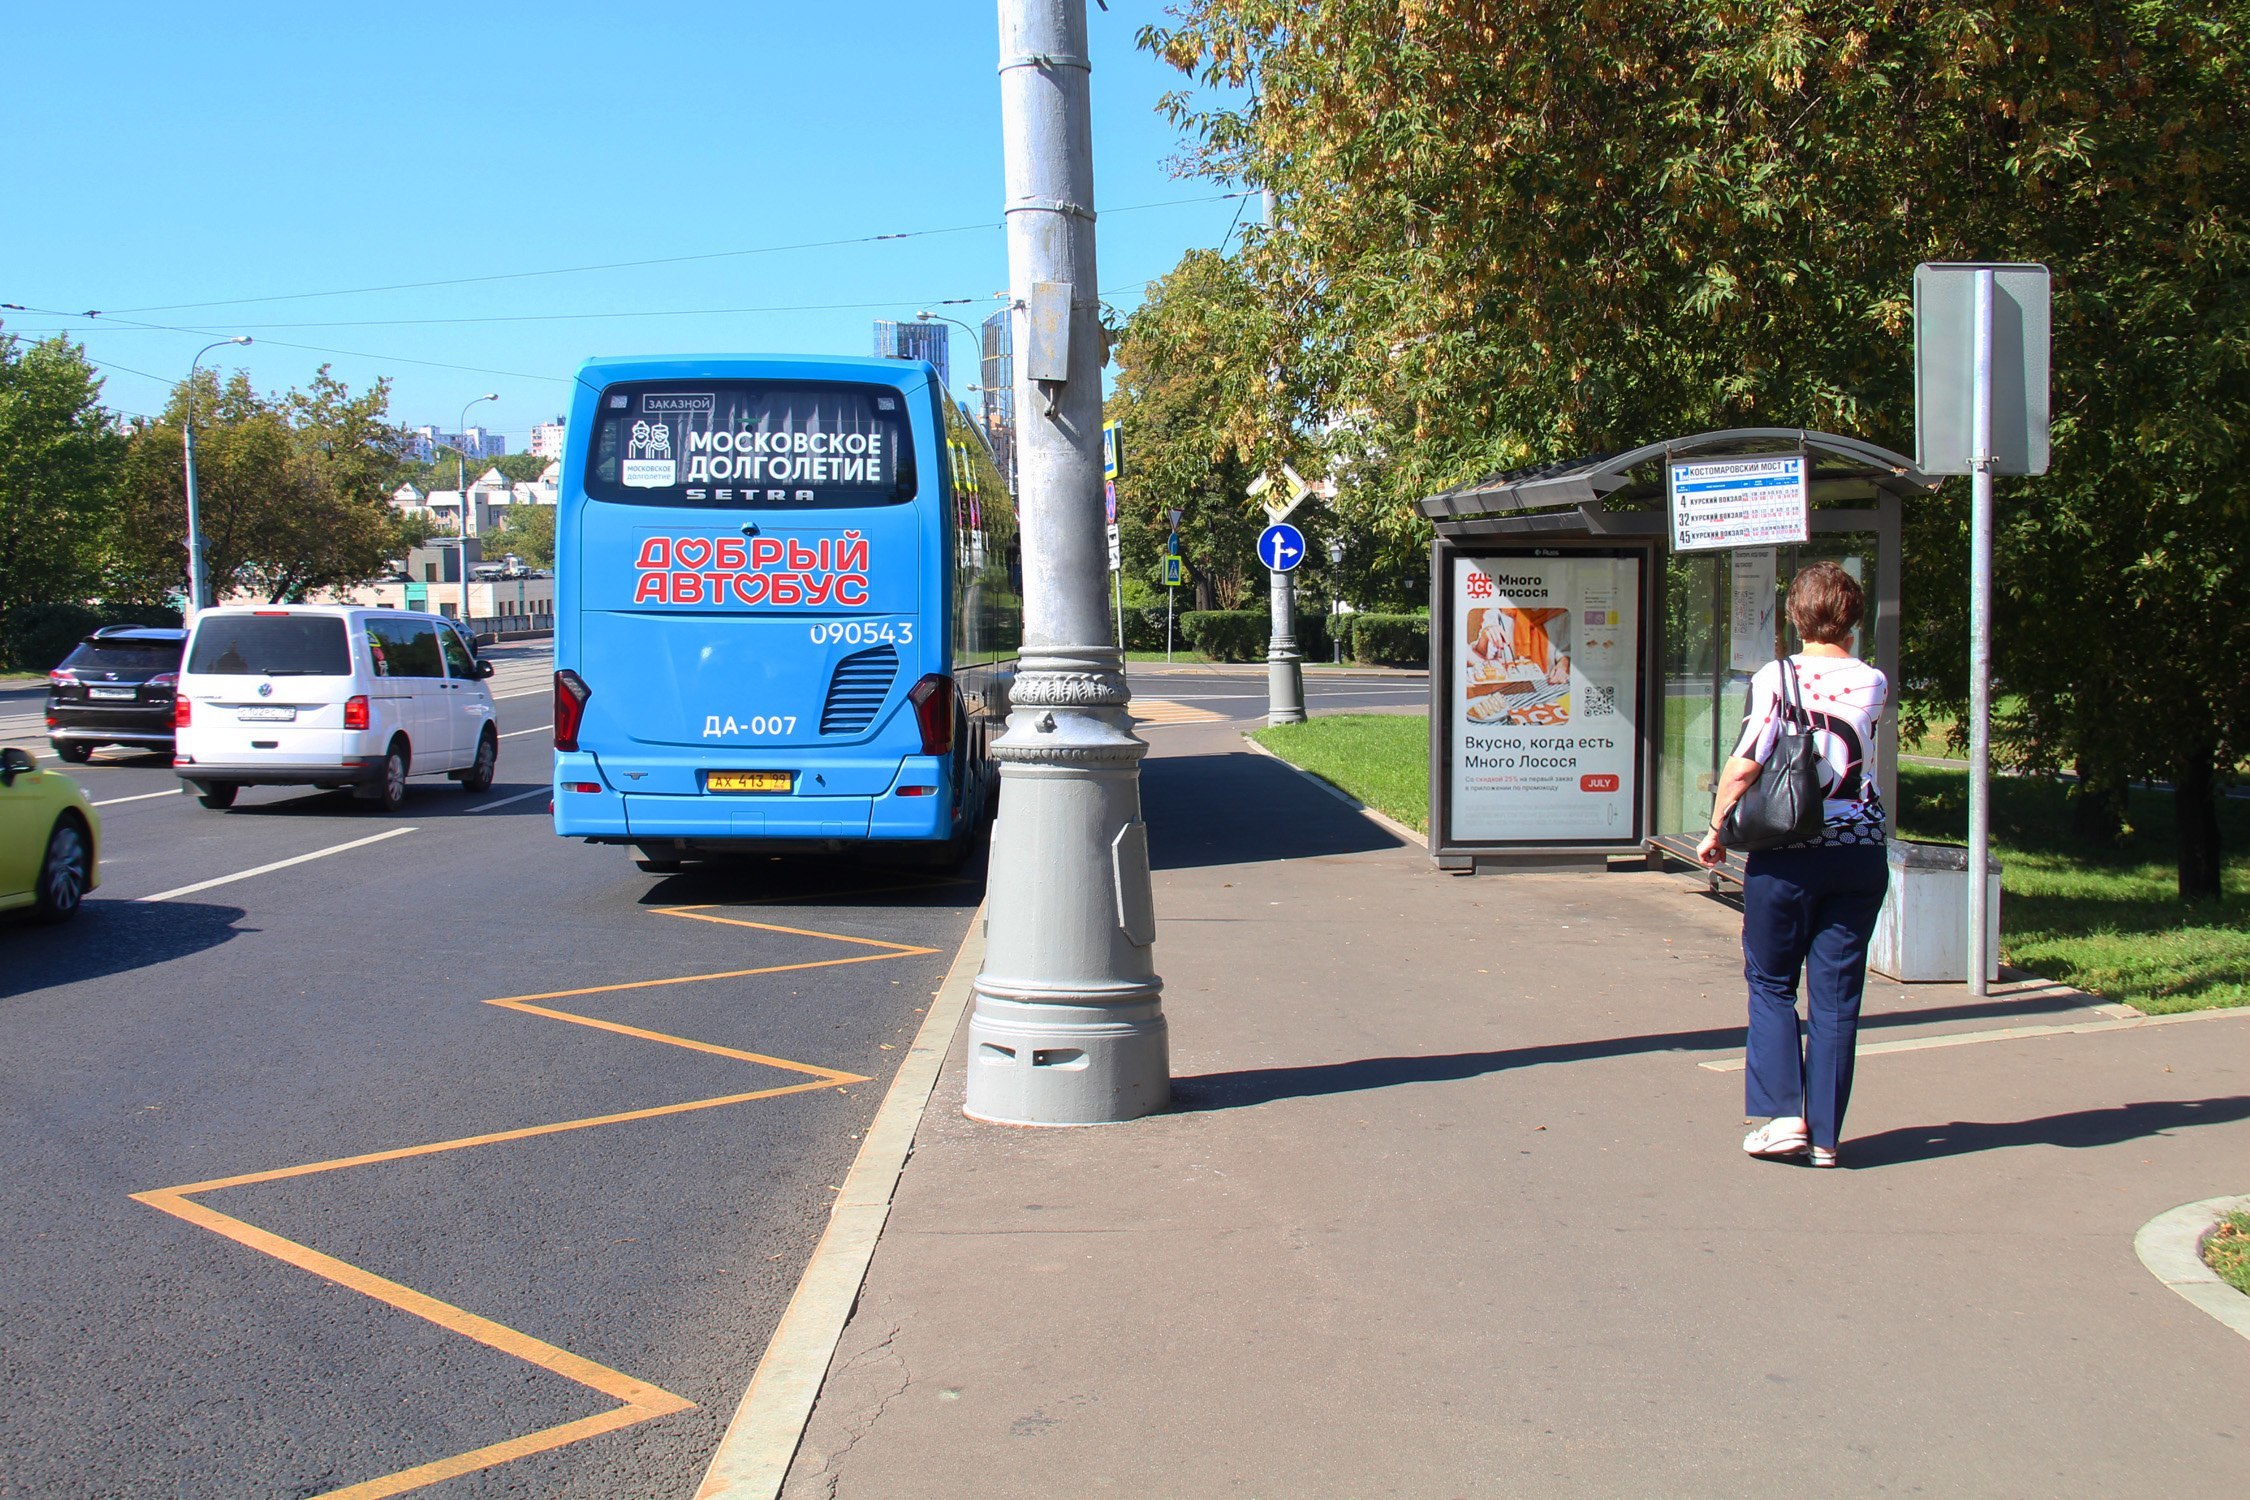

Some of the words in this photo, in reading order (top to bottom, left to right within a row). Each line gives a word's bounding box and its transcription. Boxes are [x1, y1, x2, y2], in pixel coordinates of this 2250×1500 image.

[648, 397, 710, 409] ЗАКАЗНОЙ
[689, 430, 881, 455] МОСКОВСКОЕ
[687, 456, 881, 483] ДОЛГОЛЕТИЕ
[1690, 462, 1758, 476] КОСТОМАРОВСКИЙ
[1760, 461, 1781, 471] МОСТ
[686, 489, 814, 501] SETRA
[1680, 495, 1686, 508] 4
[1690, 496, 1717, 506] КУРСКИЙ
[1719, 495, 1742, 504] ВОКЗАЛ
[1678, 512, 1689, 526] 32
[1690, 513, 1718, 522] КУРСКИЙ
[1719, 511, 1743, 520] ВОКЗАЛ
[1679, 530, 1691, 544] 45
[1691, 531, 1719, 540] КУРСКИЙ
[635, 529, 869, 572] ДОБРЫЙ
[1498, 574, 1542, 586] Много
[634, 572, 869, 606] АВТОБУС
[1498, 587, 1549, 598] лосося
[810, 622, 913, 645] 090543
[703, 715, 797, 738] ДА-007
[1465, 736, 1525, 752] Вкусно,
[1530, 738, 1574, 751] когда
[1579, 738, 1614, 749] есть
[1465, 755, 1515, 768] Много
[1519, 755, 1577, 768] Лосося
[738, 774, 764, 788] 413
[772, 773, 786, 784] 99
[1476, 775, 1503, 783] скидкой
[1529, 775, 1553, 783] первый
[1588, 779, 1611, 788] JULY
